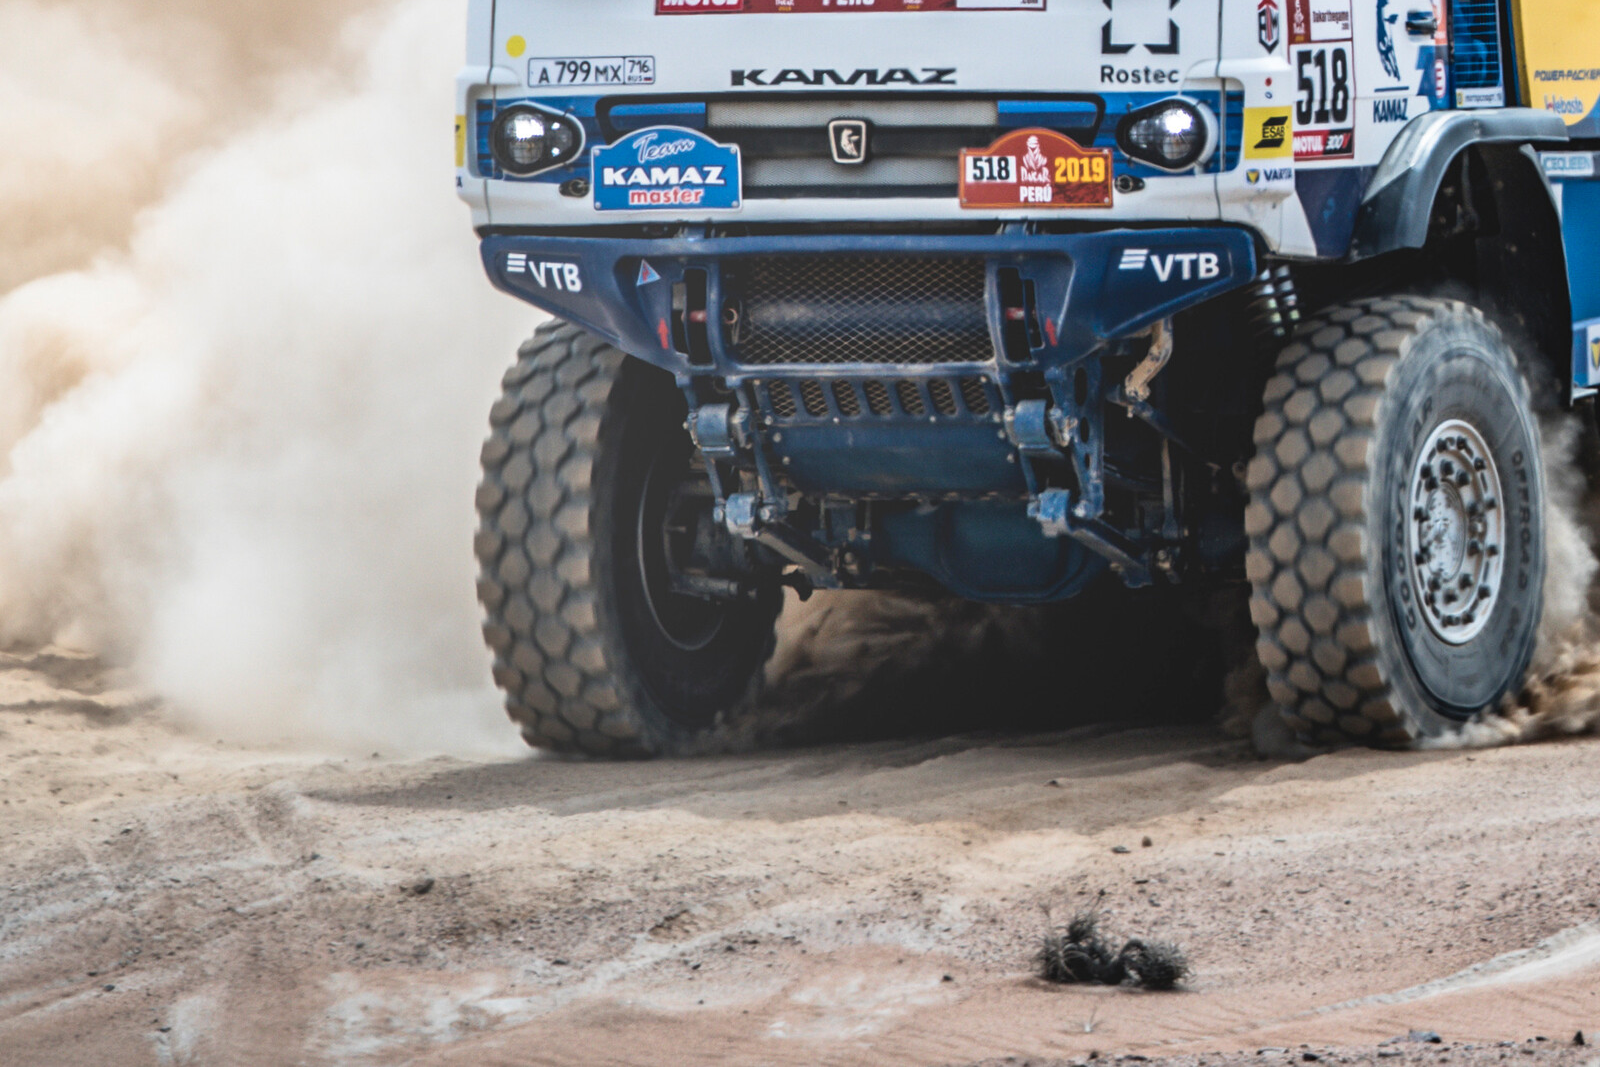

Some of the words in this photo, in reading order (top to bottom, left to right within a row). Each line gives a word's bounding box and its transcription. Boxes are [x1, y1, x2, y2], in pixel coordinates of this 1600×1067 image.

[554, 61, 591, 83] 799
[730, 68, 957, 86] KAMAZ
[1101, 65, 1179, 83] Rostec
[1296, 48, 1349, 125] 518
[1373, 98, 1409, 123] KAMAZ
[1544, 94, 1584, 114] Webasto
[1262, 126, 1285, 138] ESAB
[633, 133, 696, 164] Team
[1293, 135, 1323, 152] MOTUL
[602, 167, 726, 186] KAMAZ
[973, 157, 1010, 180] 518
[1054, 157, 1106, 182] 2019
[630, 187, 703, 204] master
[1019, 184, 1052, 202] PERÚ
[528, 261, 582, 293] VTB
[1150, 252, 1220, 282] VTB
